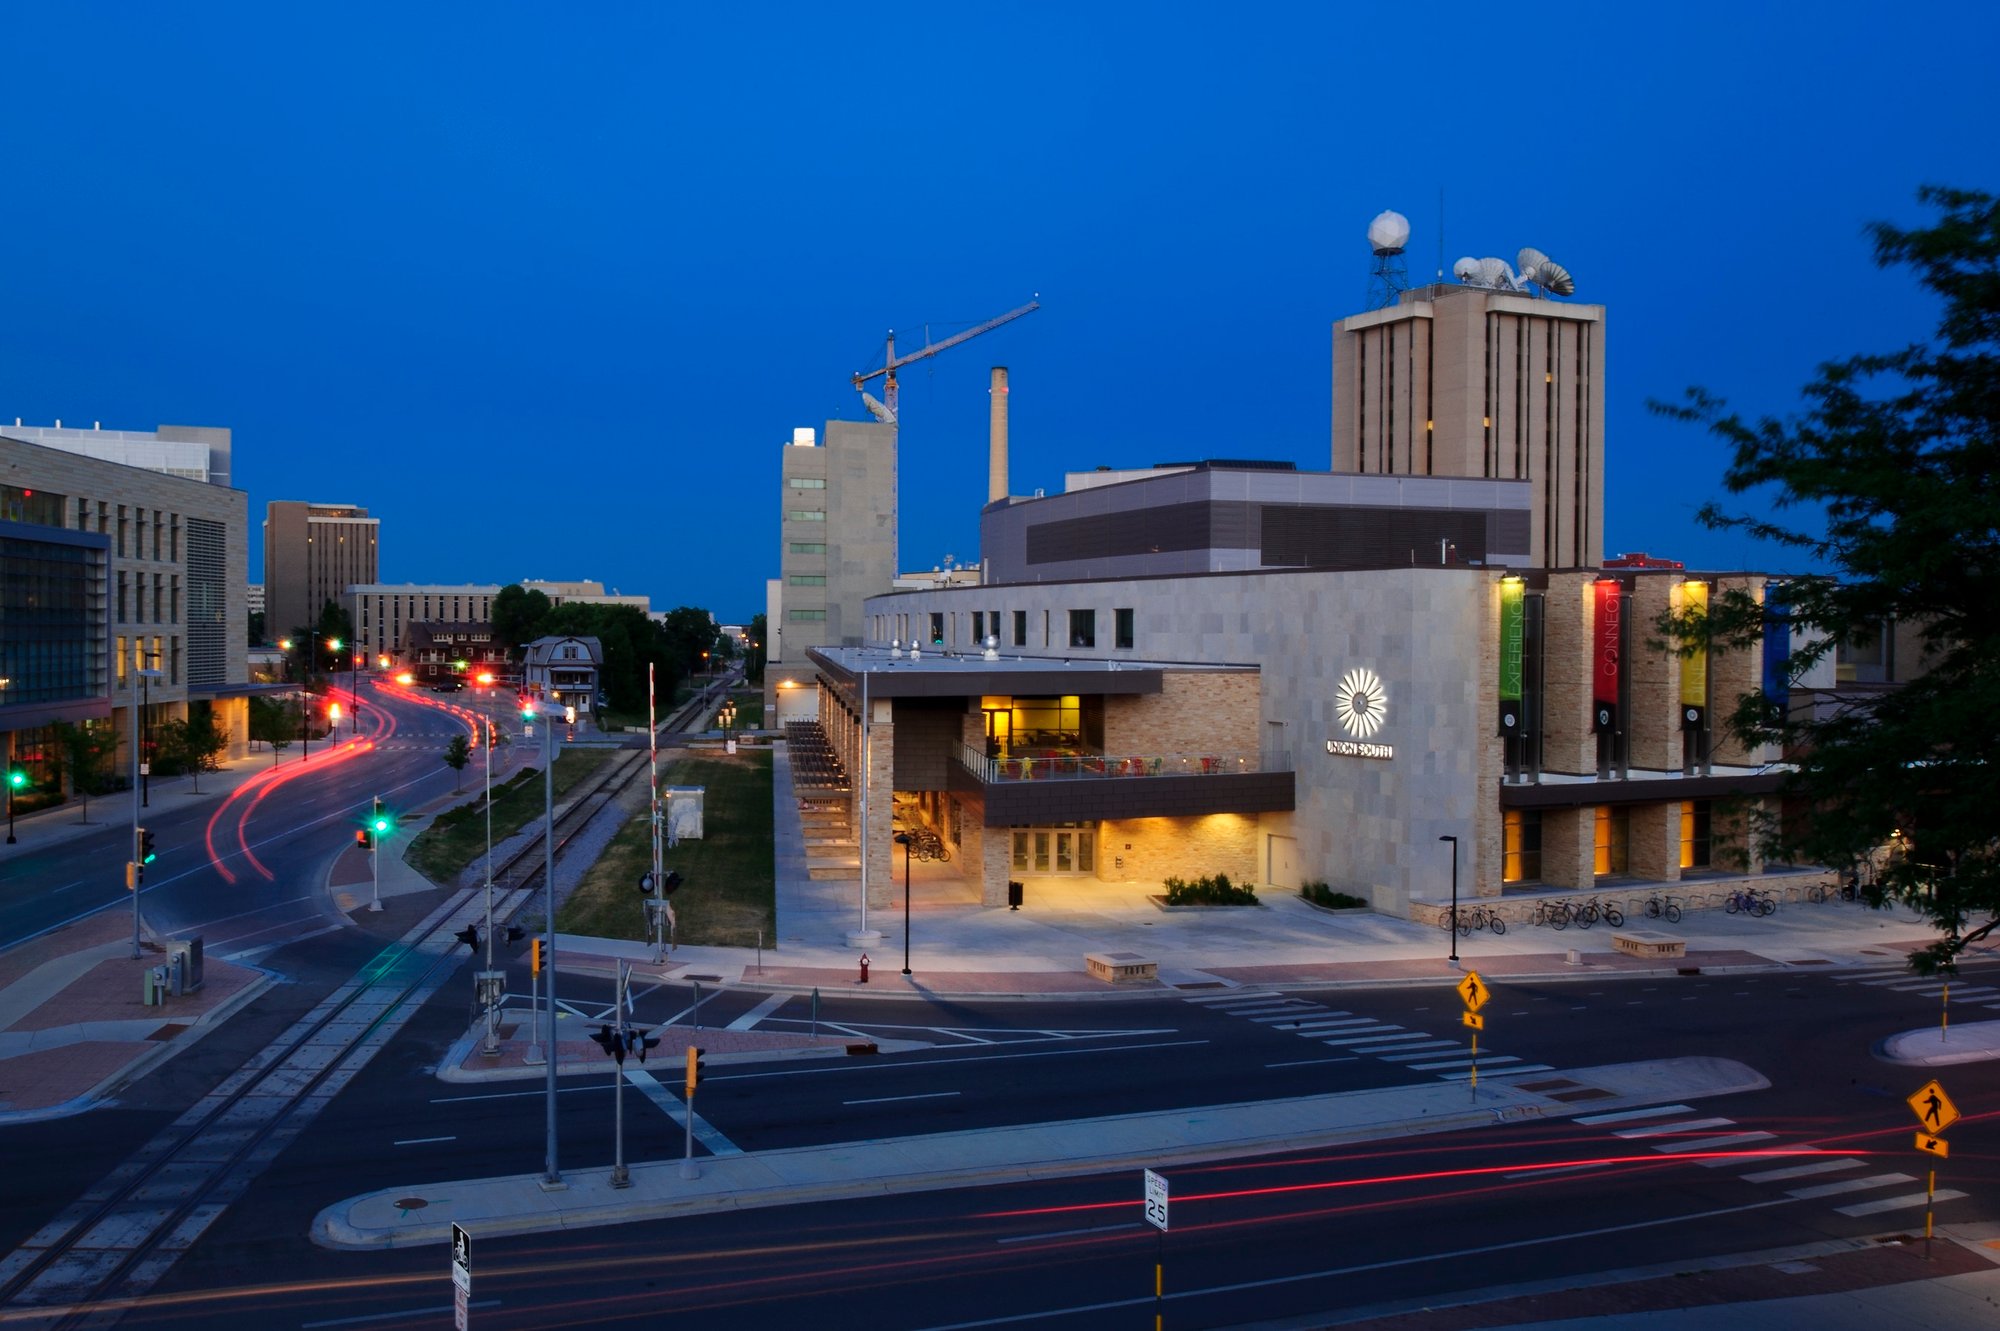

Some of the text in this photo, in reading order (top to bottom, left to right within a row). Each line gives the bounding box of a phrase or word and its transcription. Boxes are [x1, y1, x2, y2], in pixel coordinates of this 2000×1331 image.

[1508, 591, 1522, 696] EXPERIENCE
[1603, 590, 1619, 676] CONNECT
[1327, 740, 1393, 758] UNION SOUTH
[1148, 1198, 1165, 1223] 25
